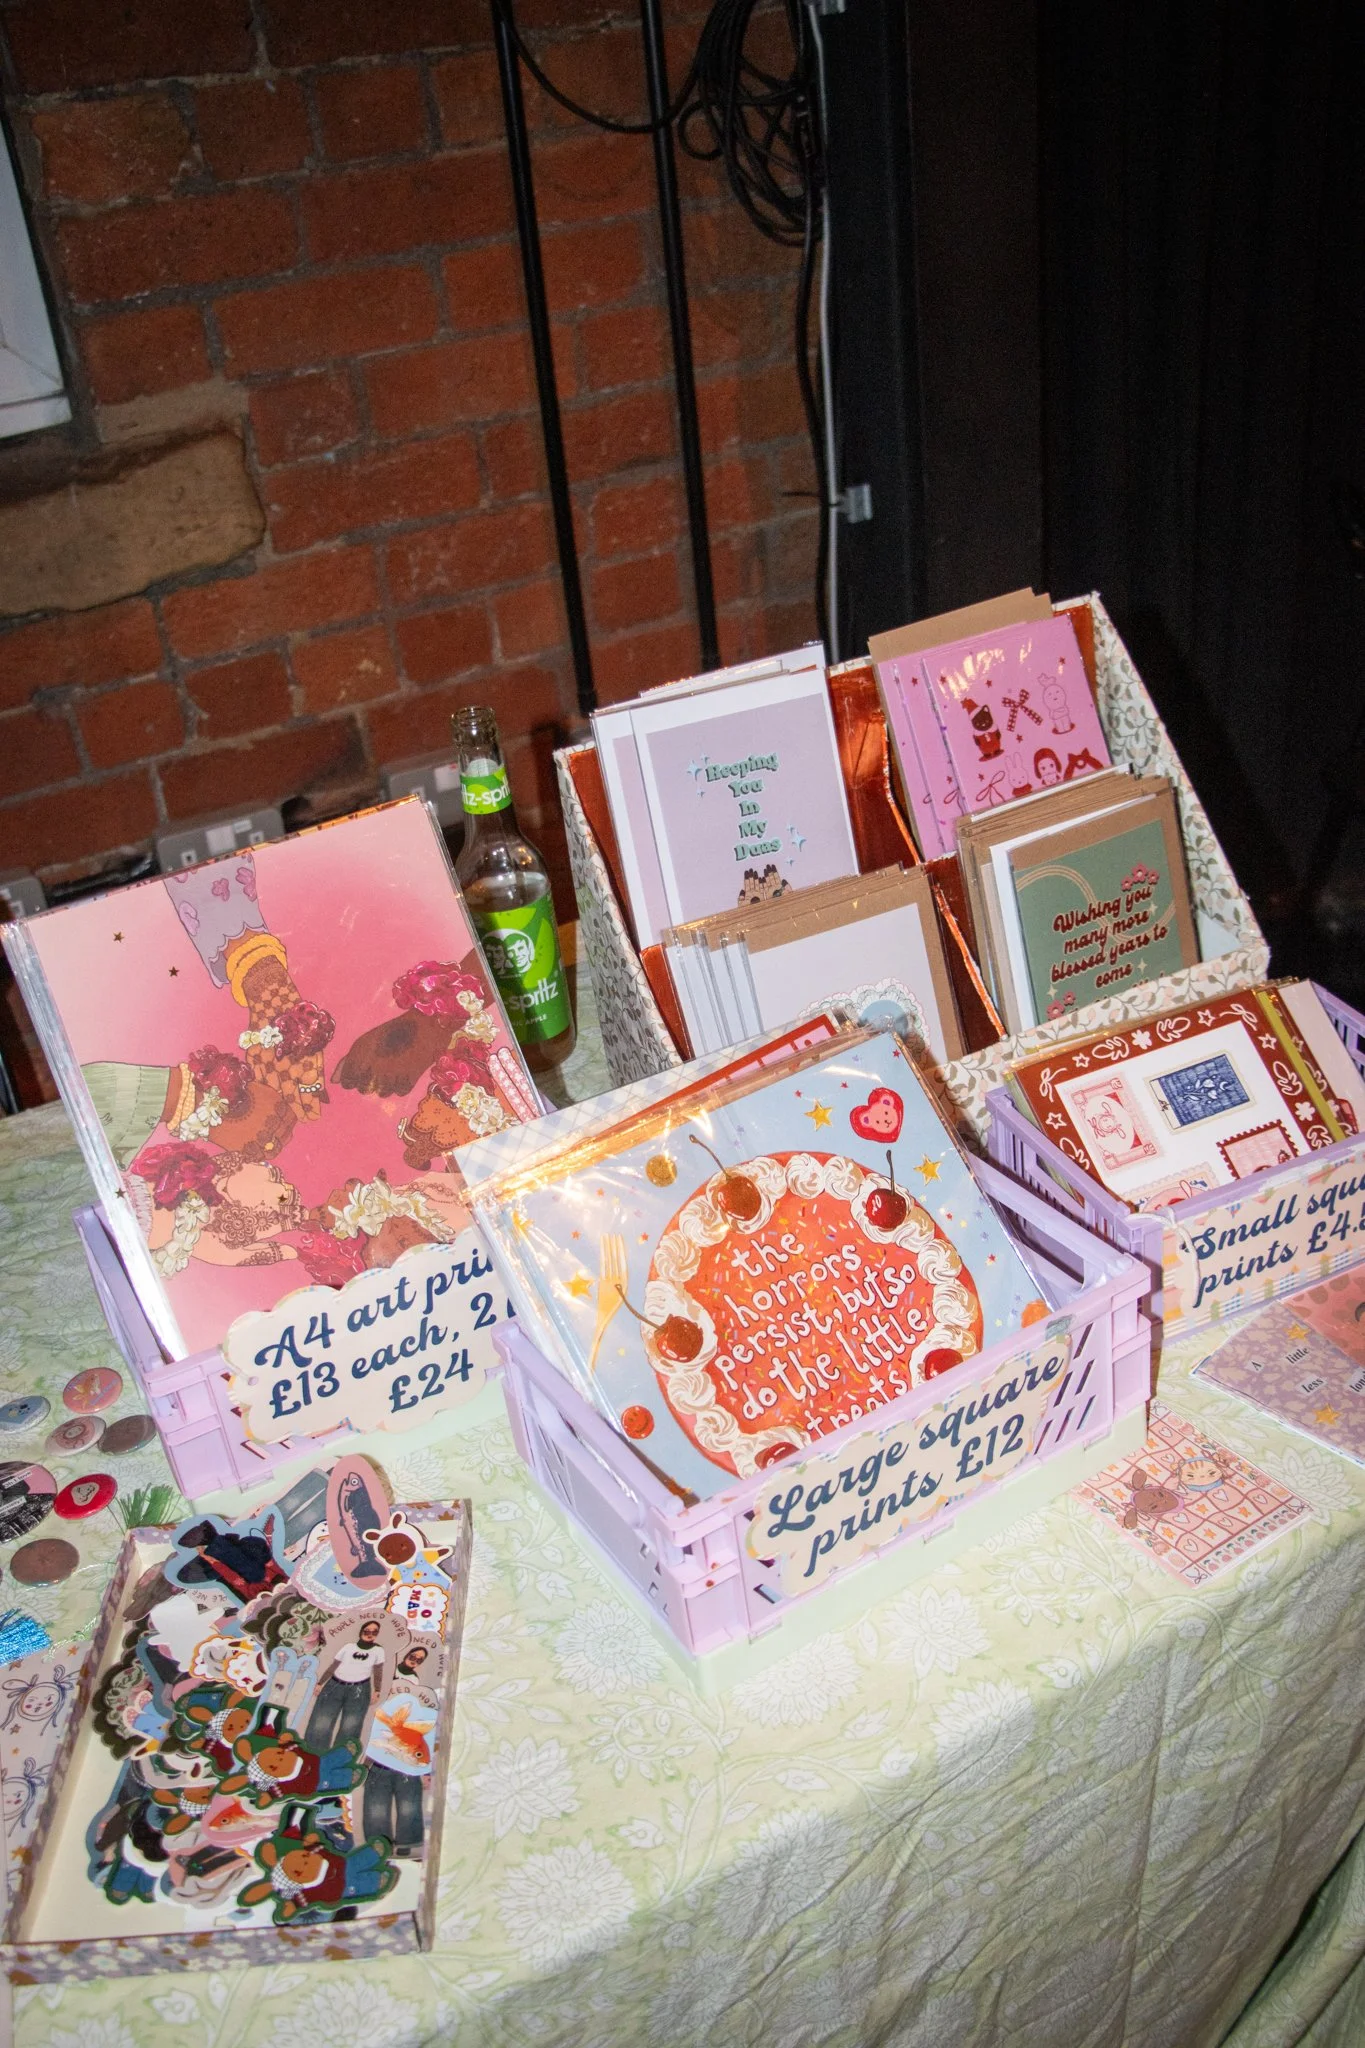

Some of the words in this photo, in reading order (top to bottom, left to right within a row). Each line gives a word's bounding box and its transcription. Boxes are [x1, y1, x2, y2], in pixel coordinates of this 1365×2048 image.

[705, 753, 779, 782] Keeping
[728, 778, 763, 798] You
[739, 800, 760, 816] In
[739, 819, 768, 839] My
[734, 838, 782, 861] Duas
[1053, 897, 1121, 933] Wishing
[1125, 886, 1153, 913] you
[1064, 926, 1108, 954] many
[1112, 910, 1150, 935] more
[1051, 949, 1106, 982] blessed
[1110, 933, 1150, 965] years
[1153, 923, 1168, 941] to
[1095, 963, 1133, 988] come
[1192, 1194, 1300, 1260] Small
[731, 1233, 804, 1277] the
[1193, 1240, 1298, 1308] prints
[724, 1244, 861, 1328] horrors
[254, 1312, 335, 1368] A4
[347, 1277, 417, 1332] art
[714, 1303, 843, 1391] persist,
[832, 1265, 898, 1314] but
[883, 1264, 916, 1295] so
[269, 1362, 340, 1419] £13
[351, 1317, 460, 1379] each,
[470, 1292, 497, 1330] 2
[742, 1382, 777, 1420] do
[769, 1350, 839, 1401] the
[836, 1308, 927, 1374] little
[1251, 1361, 1262, 1371] A
[1286, 1347, 1310, 1364] little
[388, 1349, 473, 1413] £24
[1301, 1378, 1324, 1393] less
[767, 1441, 910, 1538] Large
[919, 1356, 1064, 1450] square
[803, 1469, 943, 1577] prints
[956, 1414, 1025, 1482] £12
[328, 1618, 356, 1637] PEOPLE
[360, 1612, 386, 1620] NEED
[391, 1619, 406, 1638] HOPE
[413, 1636, 437, 1649] NEED
